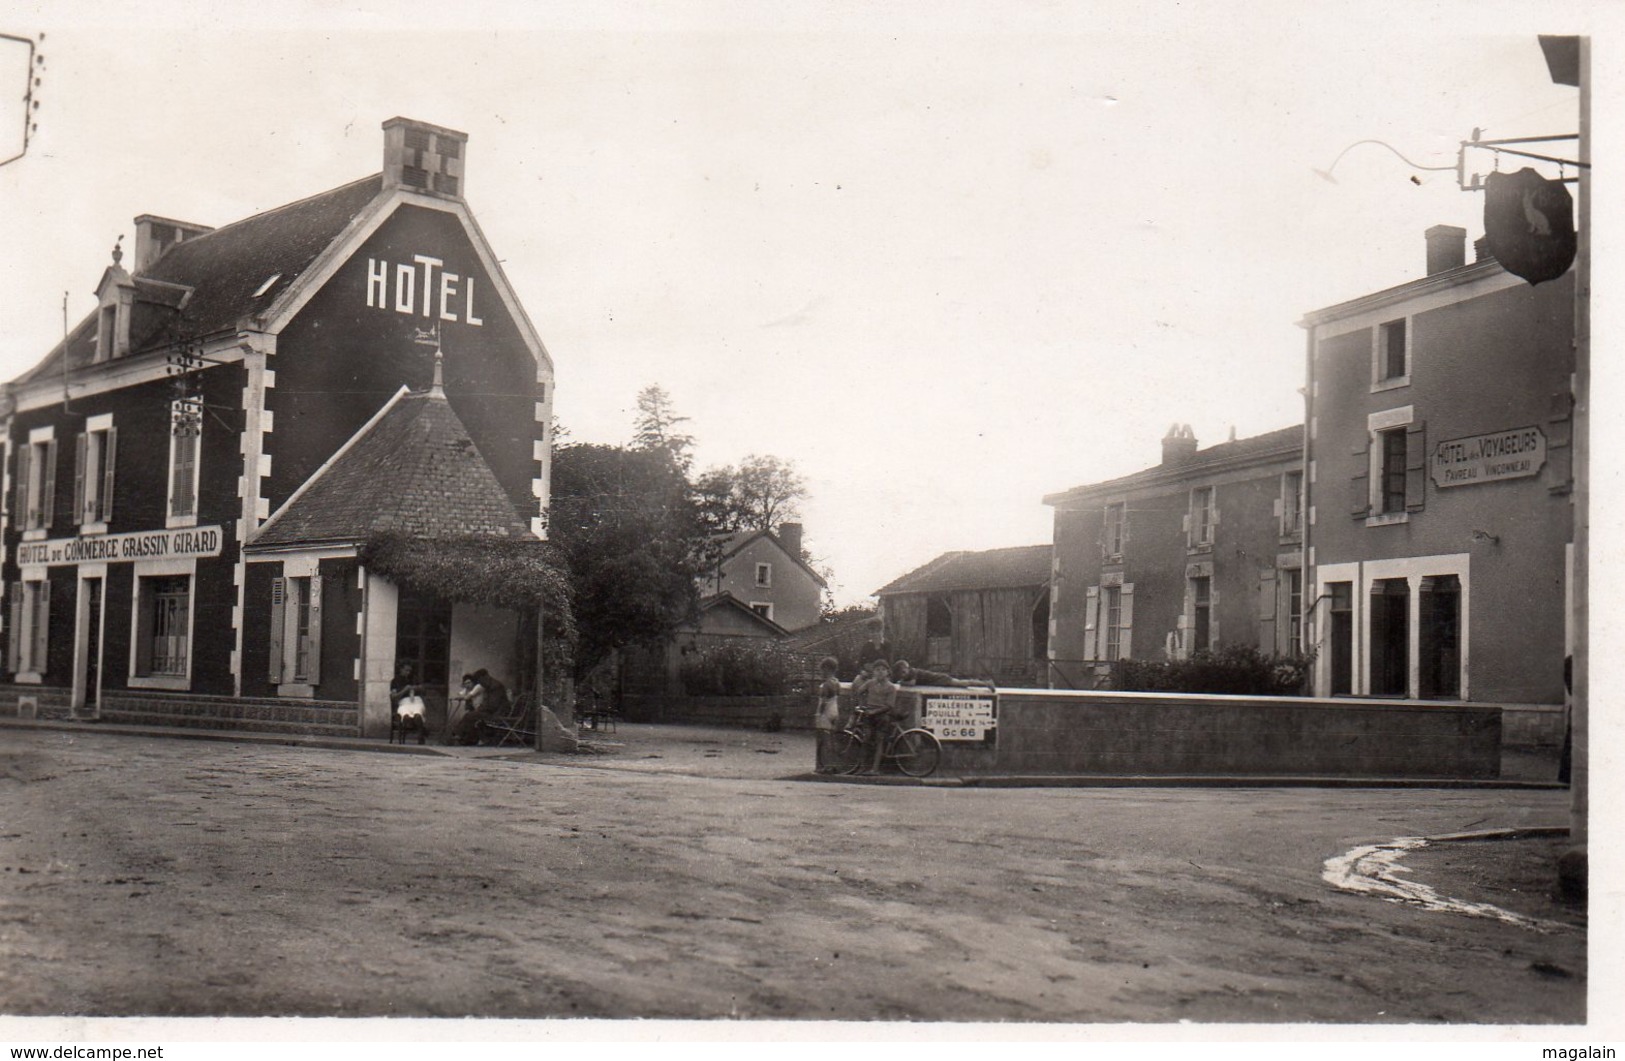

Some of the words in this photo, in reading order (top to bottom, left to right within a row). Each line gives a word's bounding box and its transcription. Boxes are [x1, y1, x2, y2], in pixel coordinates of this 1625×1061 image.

[366, 254, 483, 326] HOTEL
[1478, 431, 1537, 458] VOYAGEURS
[64, 537, 118, 561] COMMERCE
[122, 533, 168, 557] GRASSIN
[173, 530, 217, 553] GIRARD
[960, 728, 976, 737] 66
